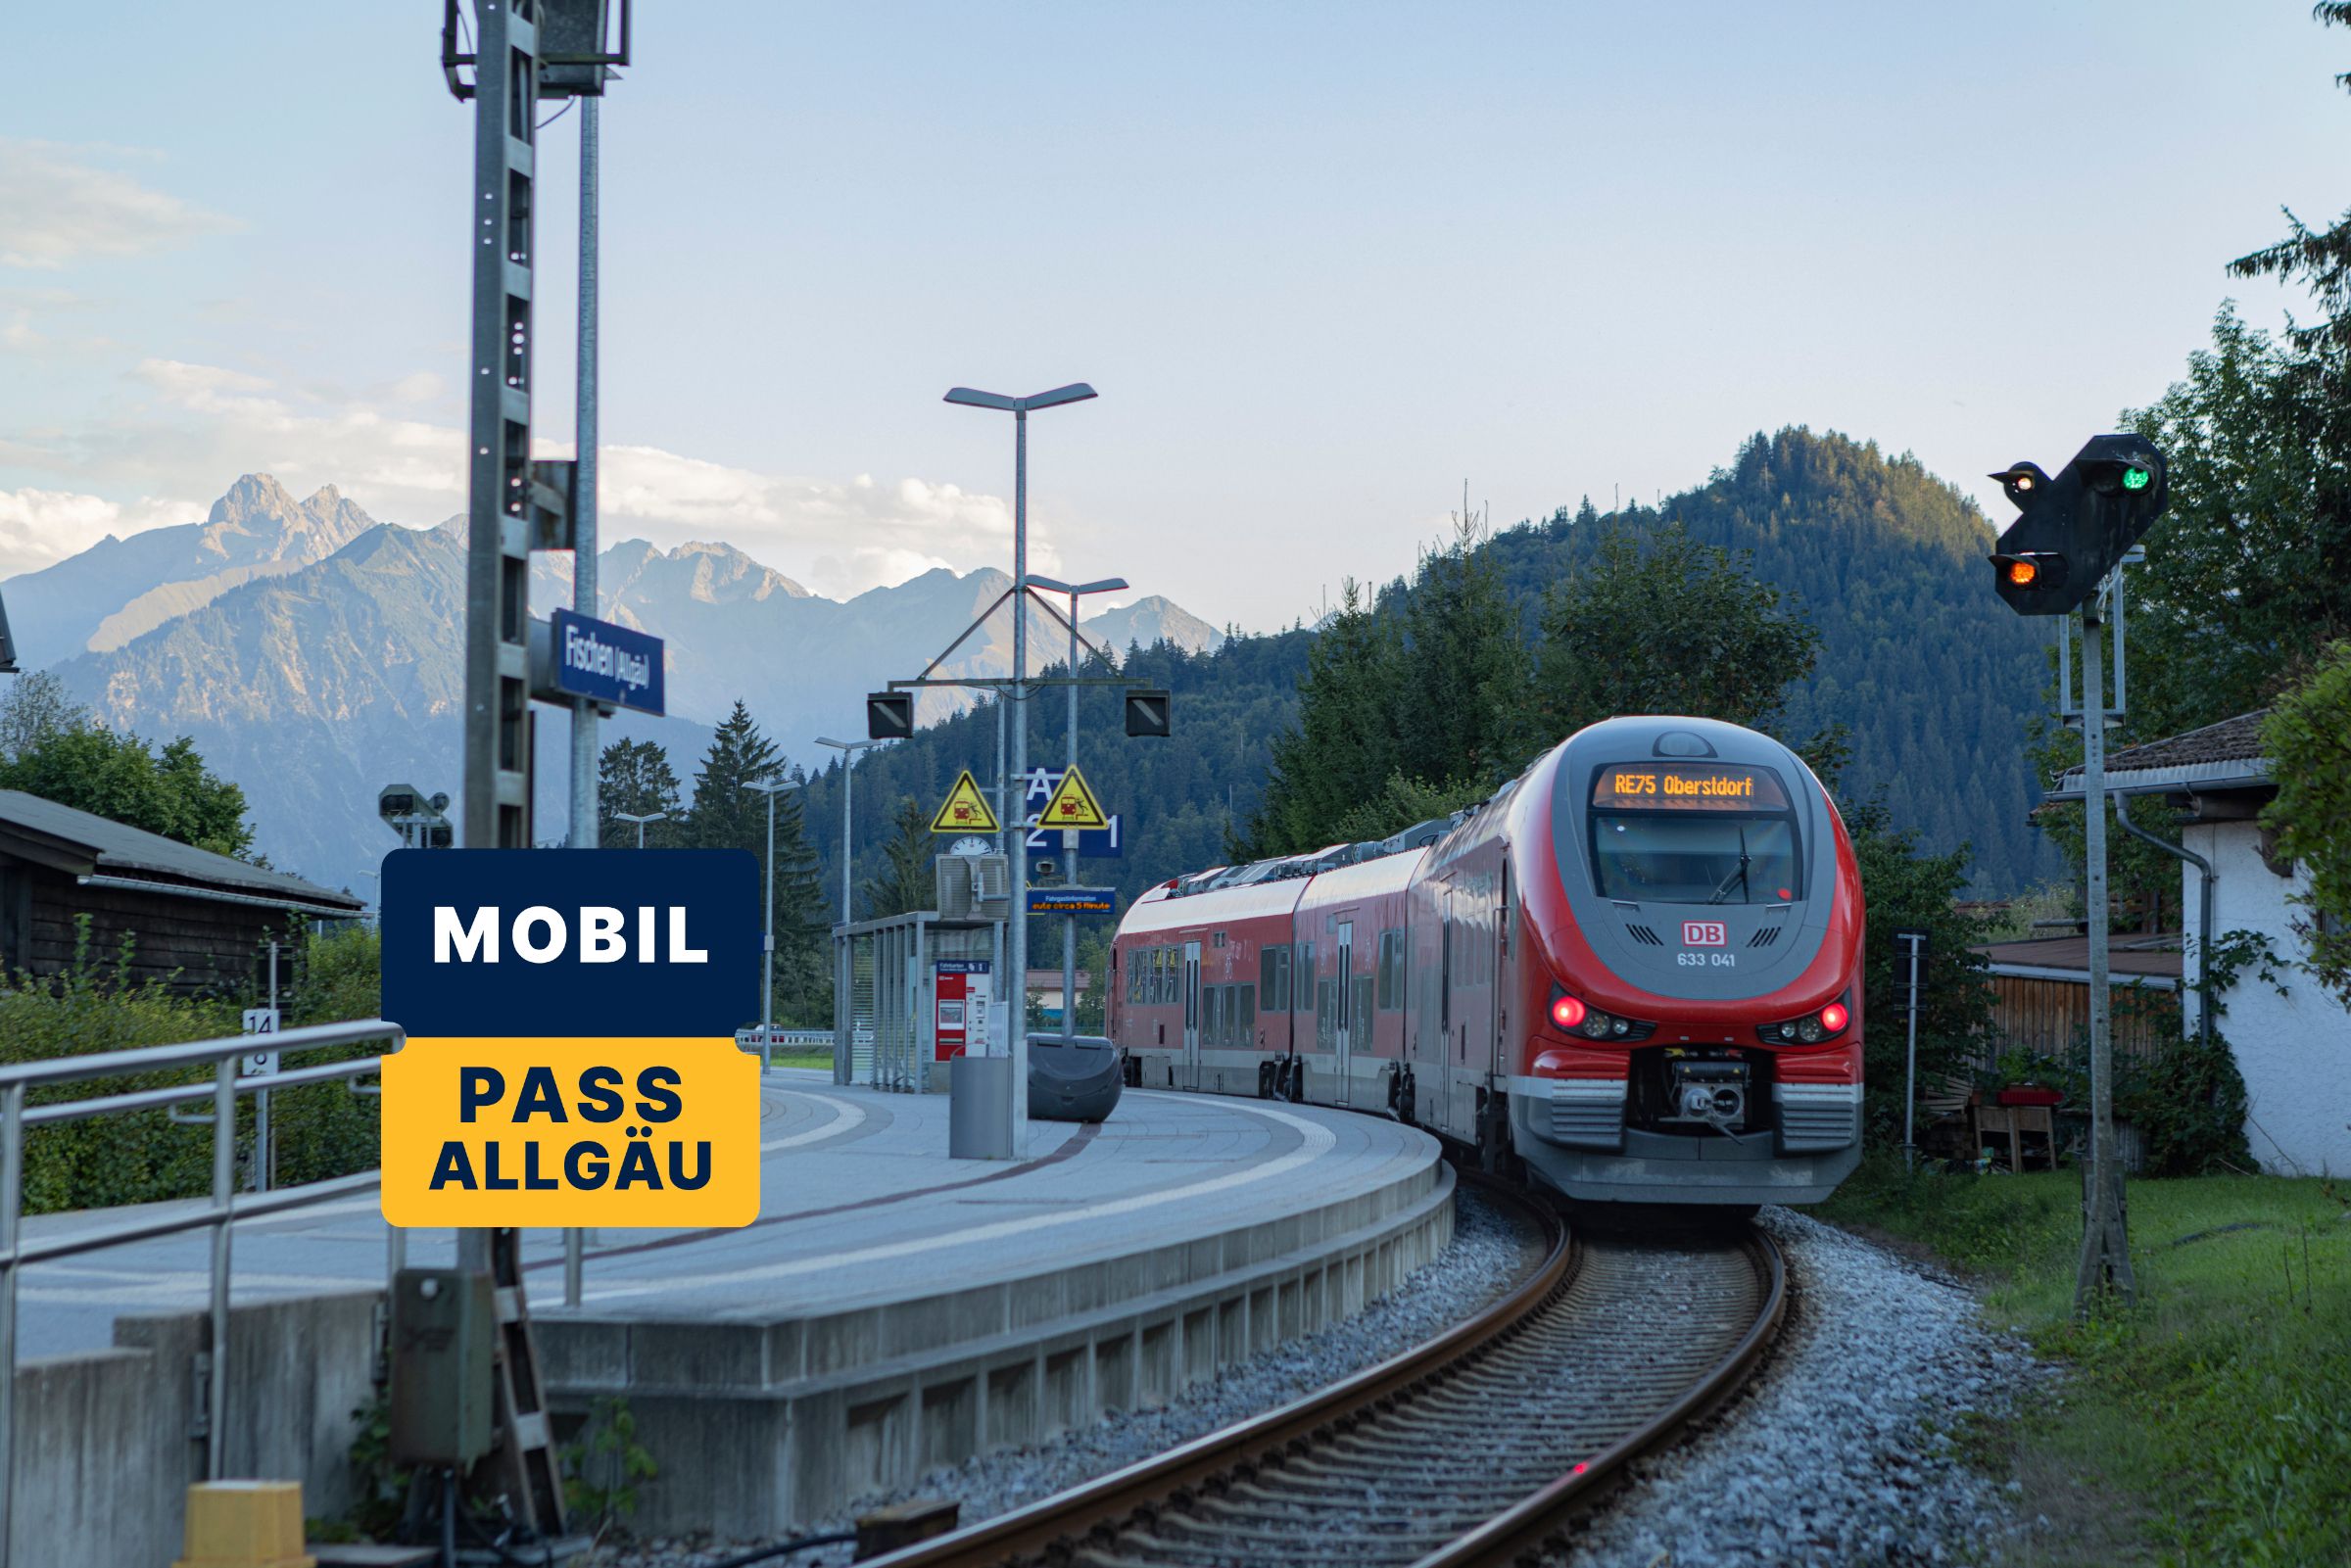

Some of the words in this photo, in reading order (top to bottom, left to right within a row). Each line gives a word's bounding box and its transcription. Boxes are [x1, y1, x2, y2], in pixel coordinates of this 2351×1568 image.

[565, 624, 613, 677] Fischen
[1027, 768, 1053, 800] A
[1614, 774, 1655, 794] RE75
[1663, 776, 1752, 796] Oberstdorf
[1107, 815, 1118, 847] 1
[1686, 925, 1723, 943] DB
[1677, 953, 1705, 967] 633
[1711, 953, 1735, 967] 041
[249, 1016, 272, 1034] 14
